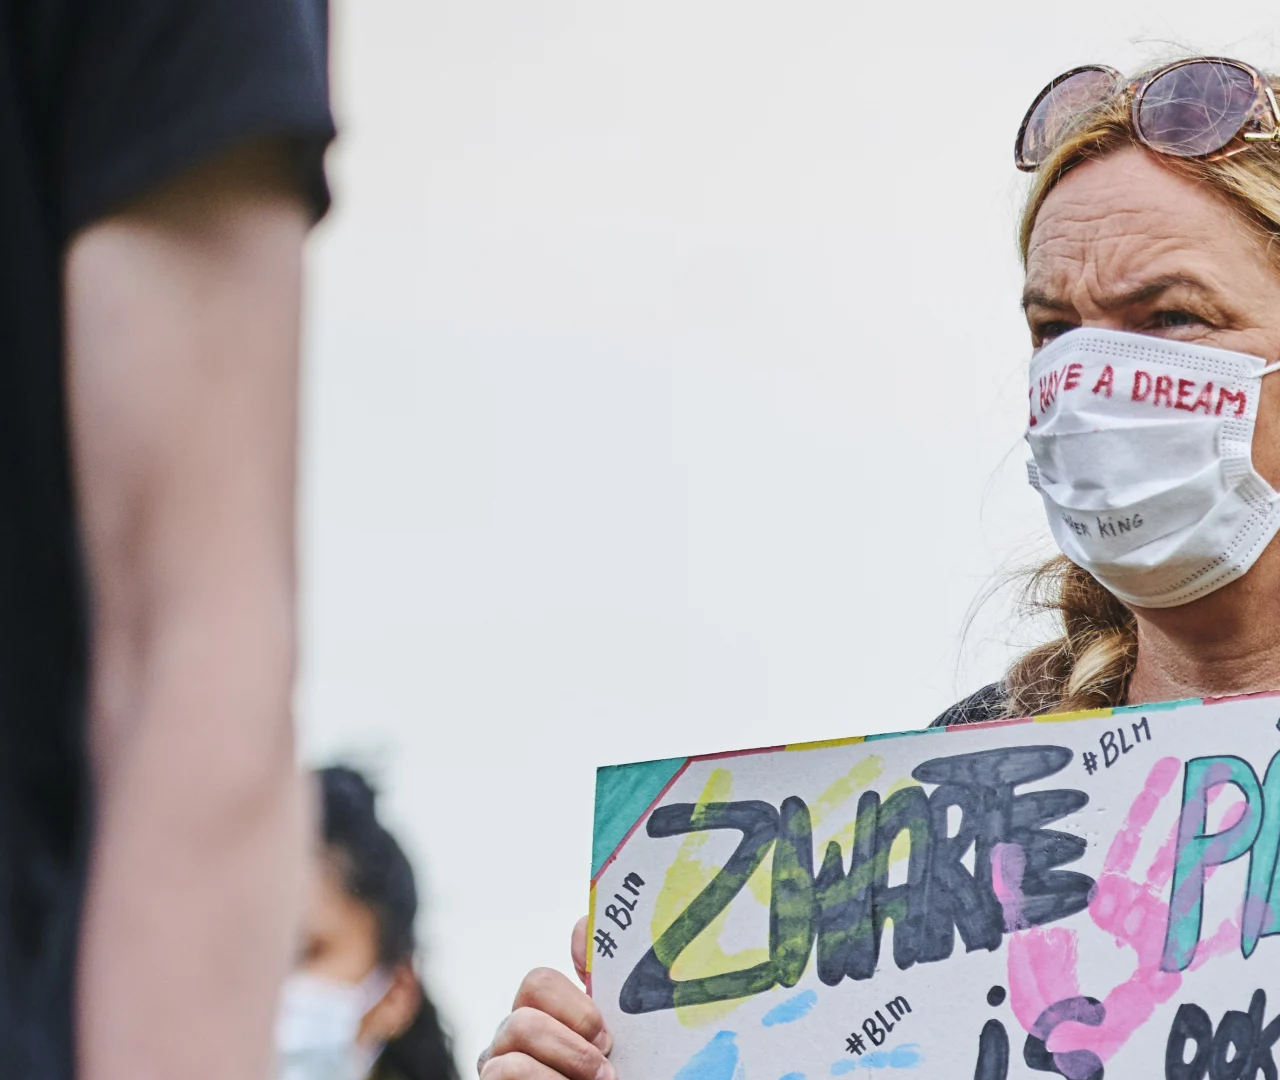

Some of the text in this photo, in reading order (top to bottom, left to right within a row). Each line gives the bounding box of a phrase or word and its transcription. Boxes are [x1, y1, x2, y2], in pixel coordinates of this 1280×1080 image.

[1039, 362, 1084, 414] HAVE
[1091, 363, 1115, 398] A
[1131, 369, 1248, 419] DREAM
[1082, 716, 1152, 776] #BLM
[618, 743, 1099, 1015] ZWARTE
[594, 871, 646, 960] #BLm
[845, 994, 913, 1057] #BLm
